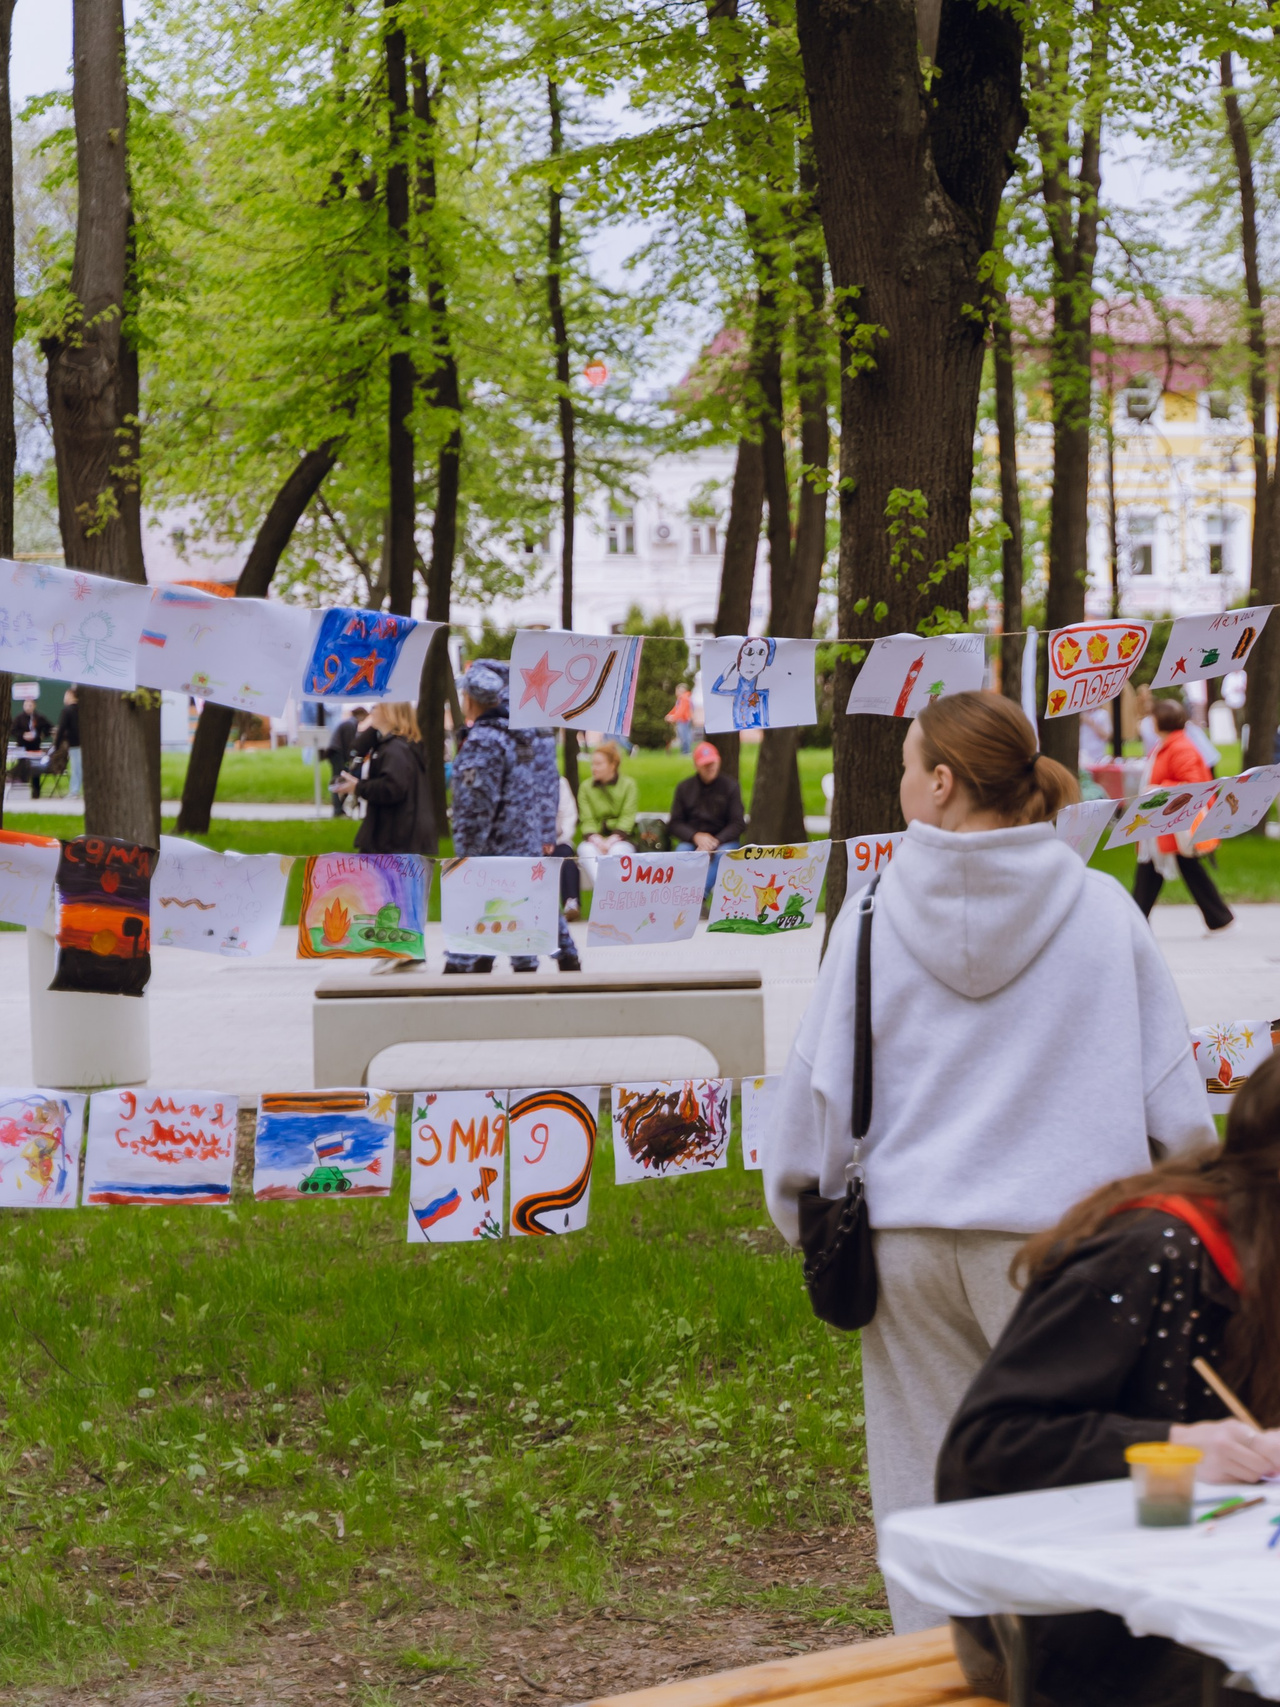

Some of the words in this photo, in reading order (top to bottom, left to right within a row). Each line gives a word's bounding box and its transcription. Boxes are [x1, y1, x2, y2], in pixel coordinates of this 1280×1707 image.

[345, 618, 398, 640] МАЯ
[313, 653, 340, 694] 9
[548, 653, 598, 717] 9
[620, 856, 632, 882] 9
[635, 865, 674, 885] МАЯ
[119, 1091, 137, 1120] 9
[416, 1124, 442, 1166] 9
[447, 1114, 506, 1164] МАЯ
[523, 1123, 549, 1164] 9
